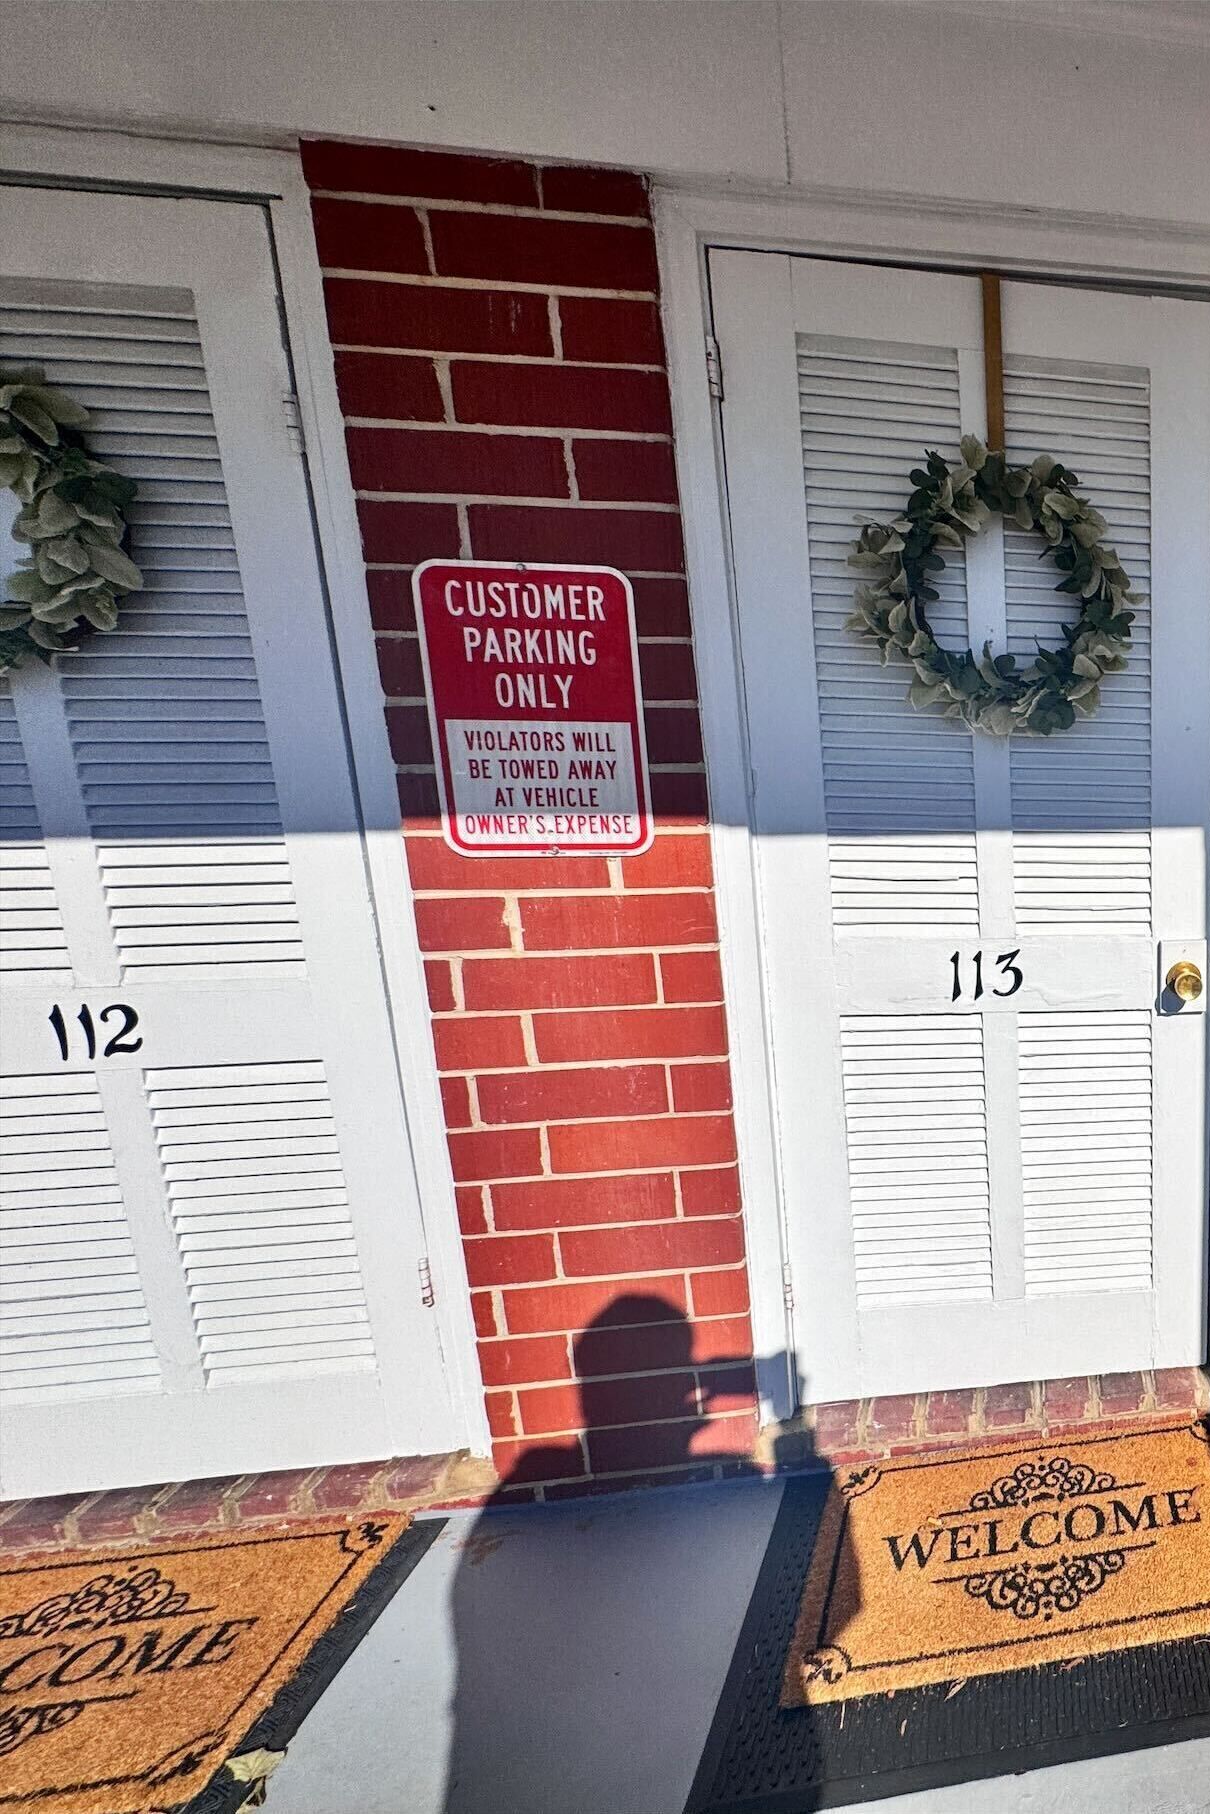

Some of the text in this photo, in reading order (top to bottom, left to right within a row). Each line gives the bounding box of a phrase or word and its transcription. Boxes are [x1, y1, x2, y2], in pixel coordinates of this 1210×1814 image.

[444, 579, 606, 622] CUSTOMER
[463, 627, 597, 665] PARKING
[495, 673, 574, 709] ONLY
[463, 730, 616, 753] VIOLATORS WILL
[468, 759, 617, 780] BE TOWED AWAY
[495, 787, 600, 807] AT VEHICLE
[465, 815, 633, 835] OWNER'S EXPENSE
[949, 948, 1024, 1003] 113
[48, 1003, 144, 1061] 112
[881, 1484, 1202, 1572] WELCOME
